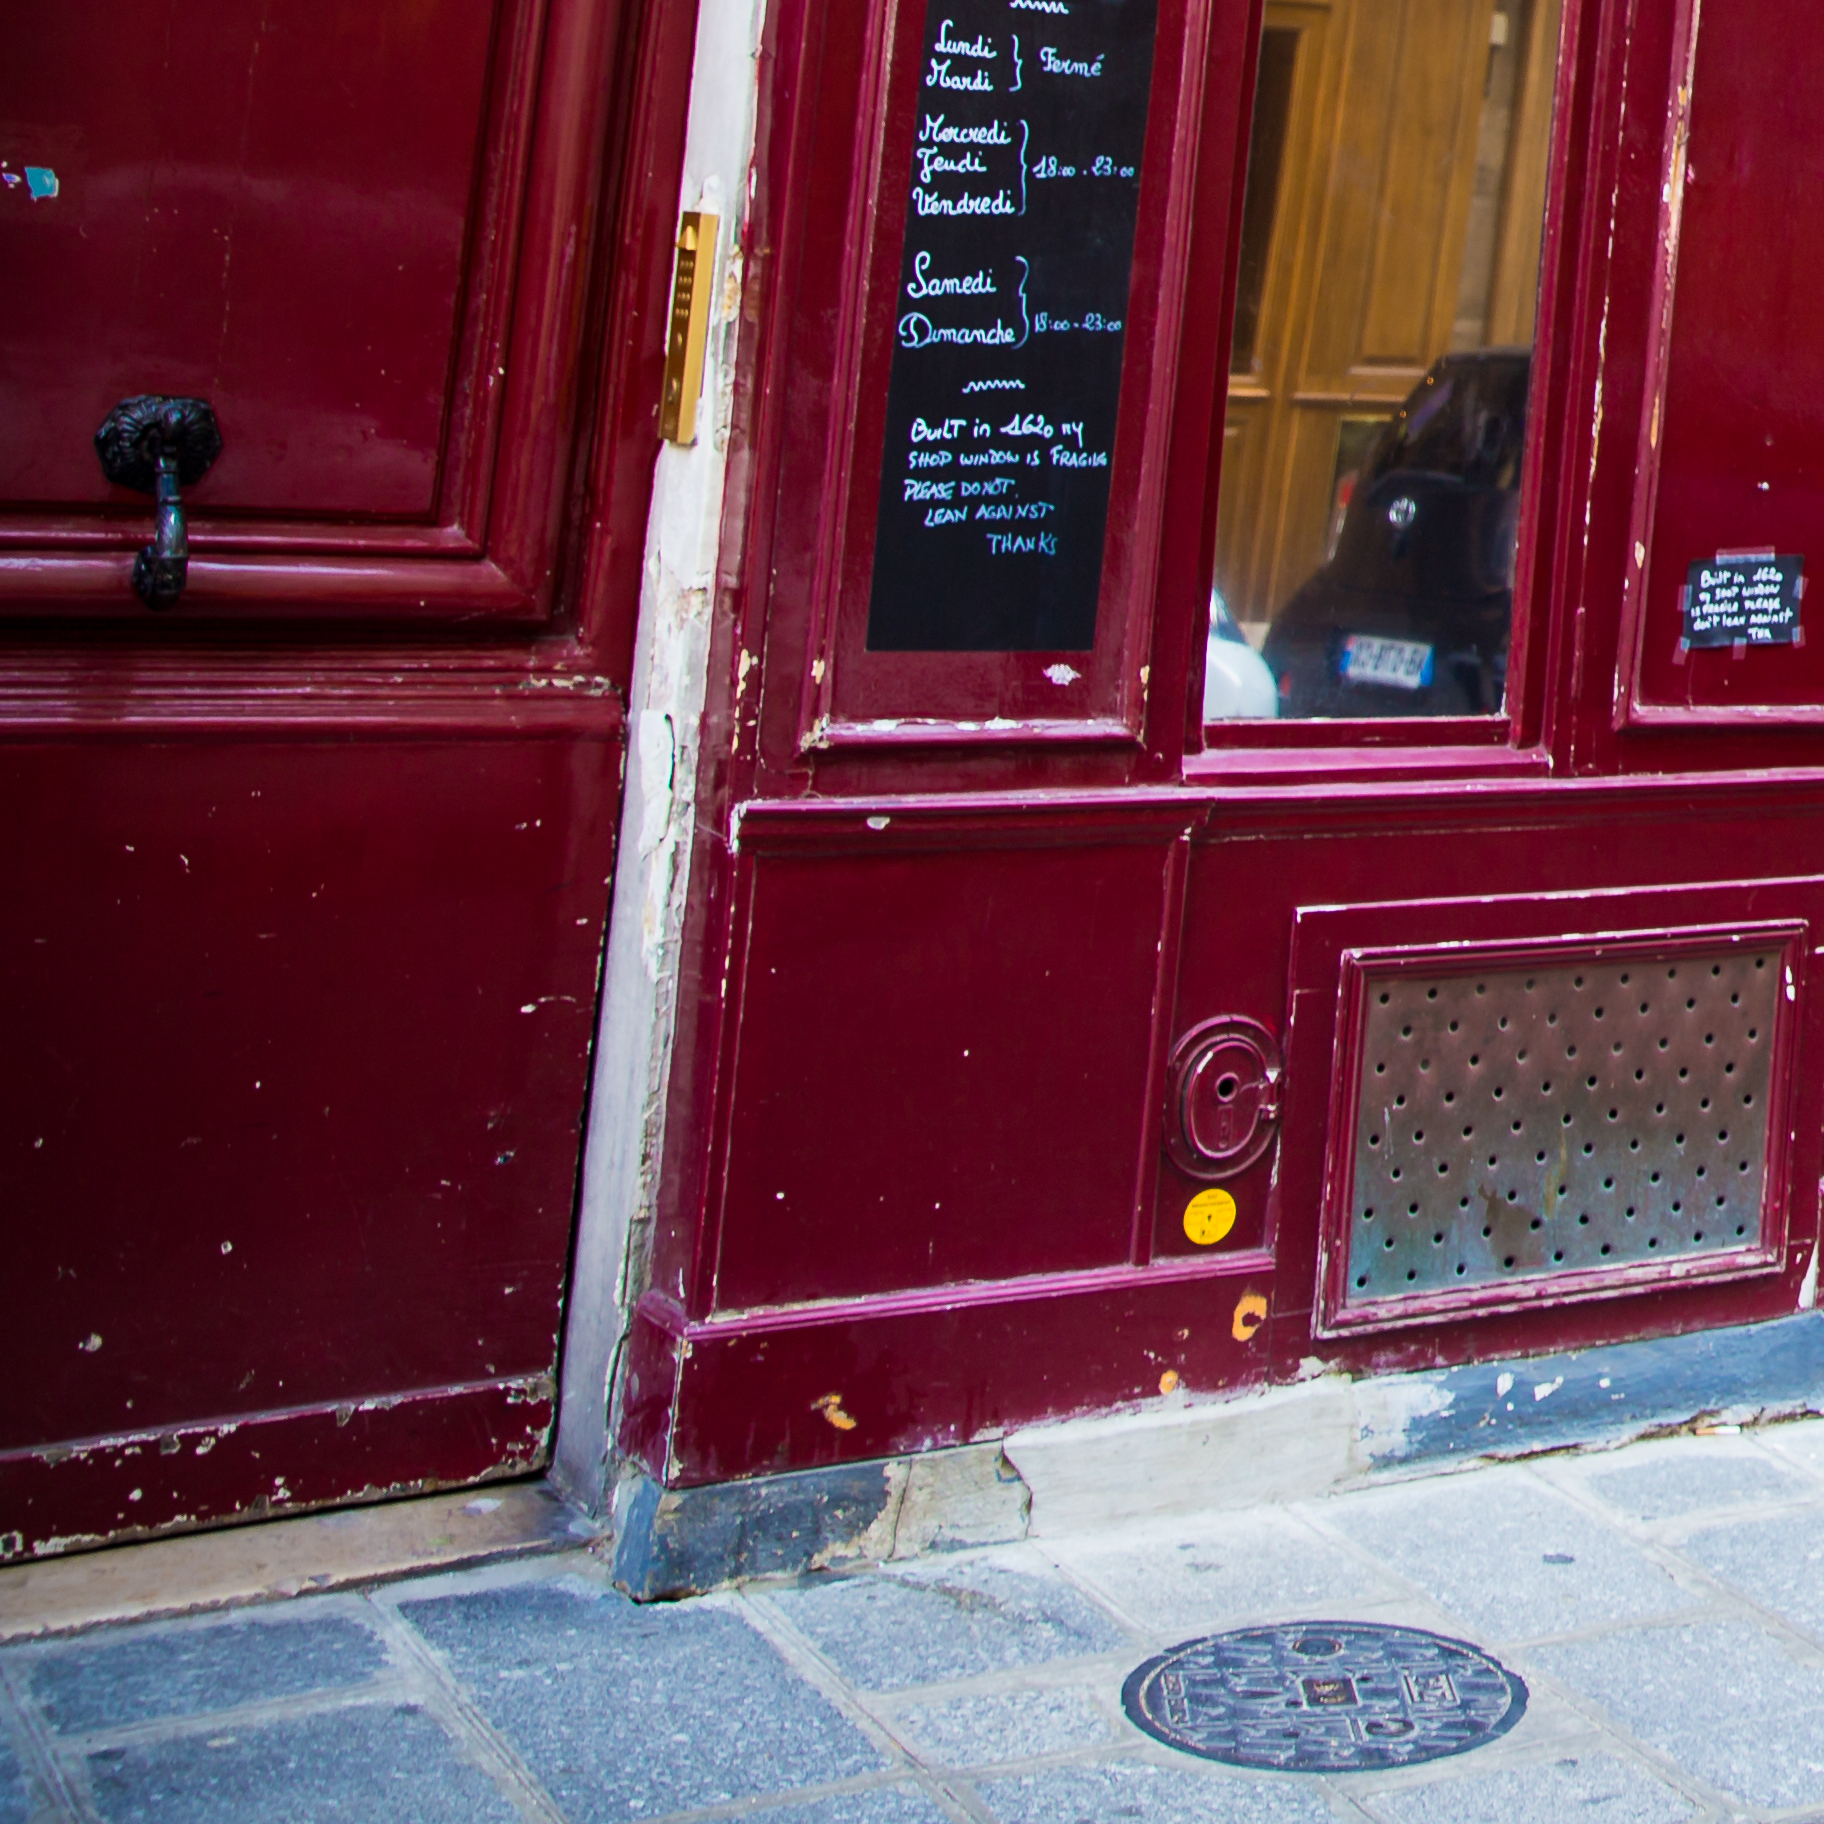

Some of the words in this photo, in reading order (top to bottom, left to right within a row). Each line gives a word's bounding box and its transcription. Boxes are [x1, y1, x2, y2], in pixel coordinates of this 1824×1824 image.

[933, 18, 998, 60] Lundi
[925, 57, 994, 93] Mardi
[1039, 45, 1106, 78] Fermé
[918, 113, 1013, 146] Mercredi
[915, 146, 988, 184] Jeudi
[912, 186, 1017, 218] Vendredi
[906, 250, 997, 299] Samedi
[898, 311, 1016, 349] Dimanche
[973, 418, 991, 439] in
[1000, 414, 1054, 439] 1620
[908, 450, 953, 470] SHOP
[903, 478, 957, 502] PLEASE
[923, 505, 969, 528] LEAN
[974, 500, 1056, 522] AGAINST
[986, 530, 1059, 557] THANKS
